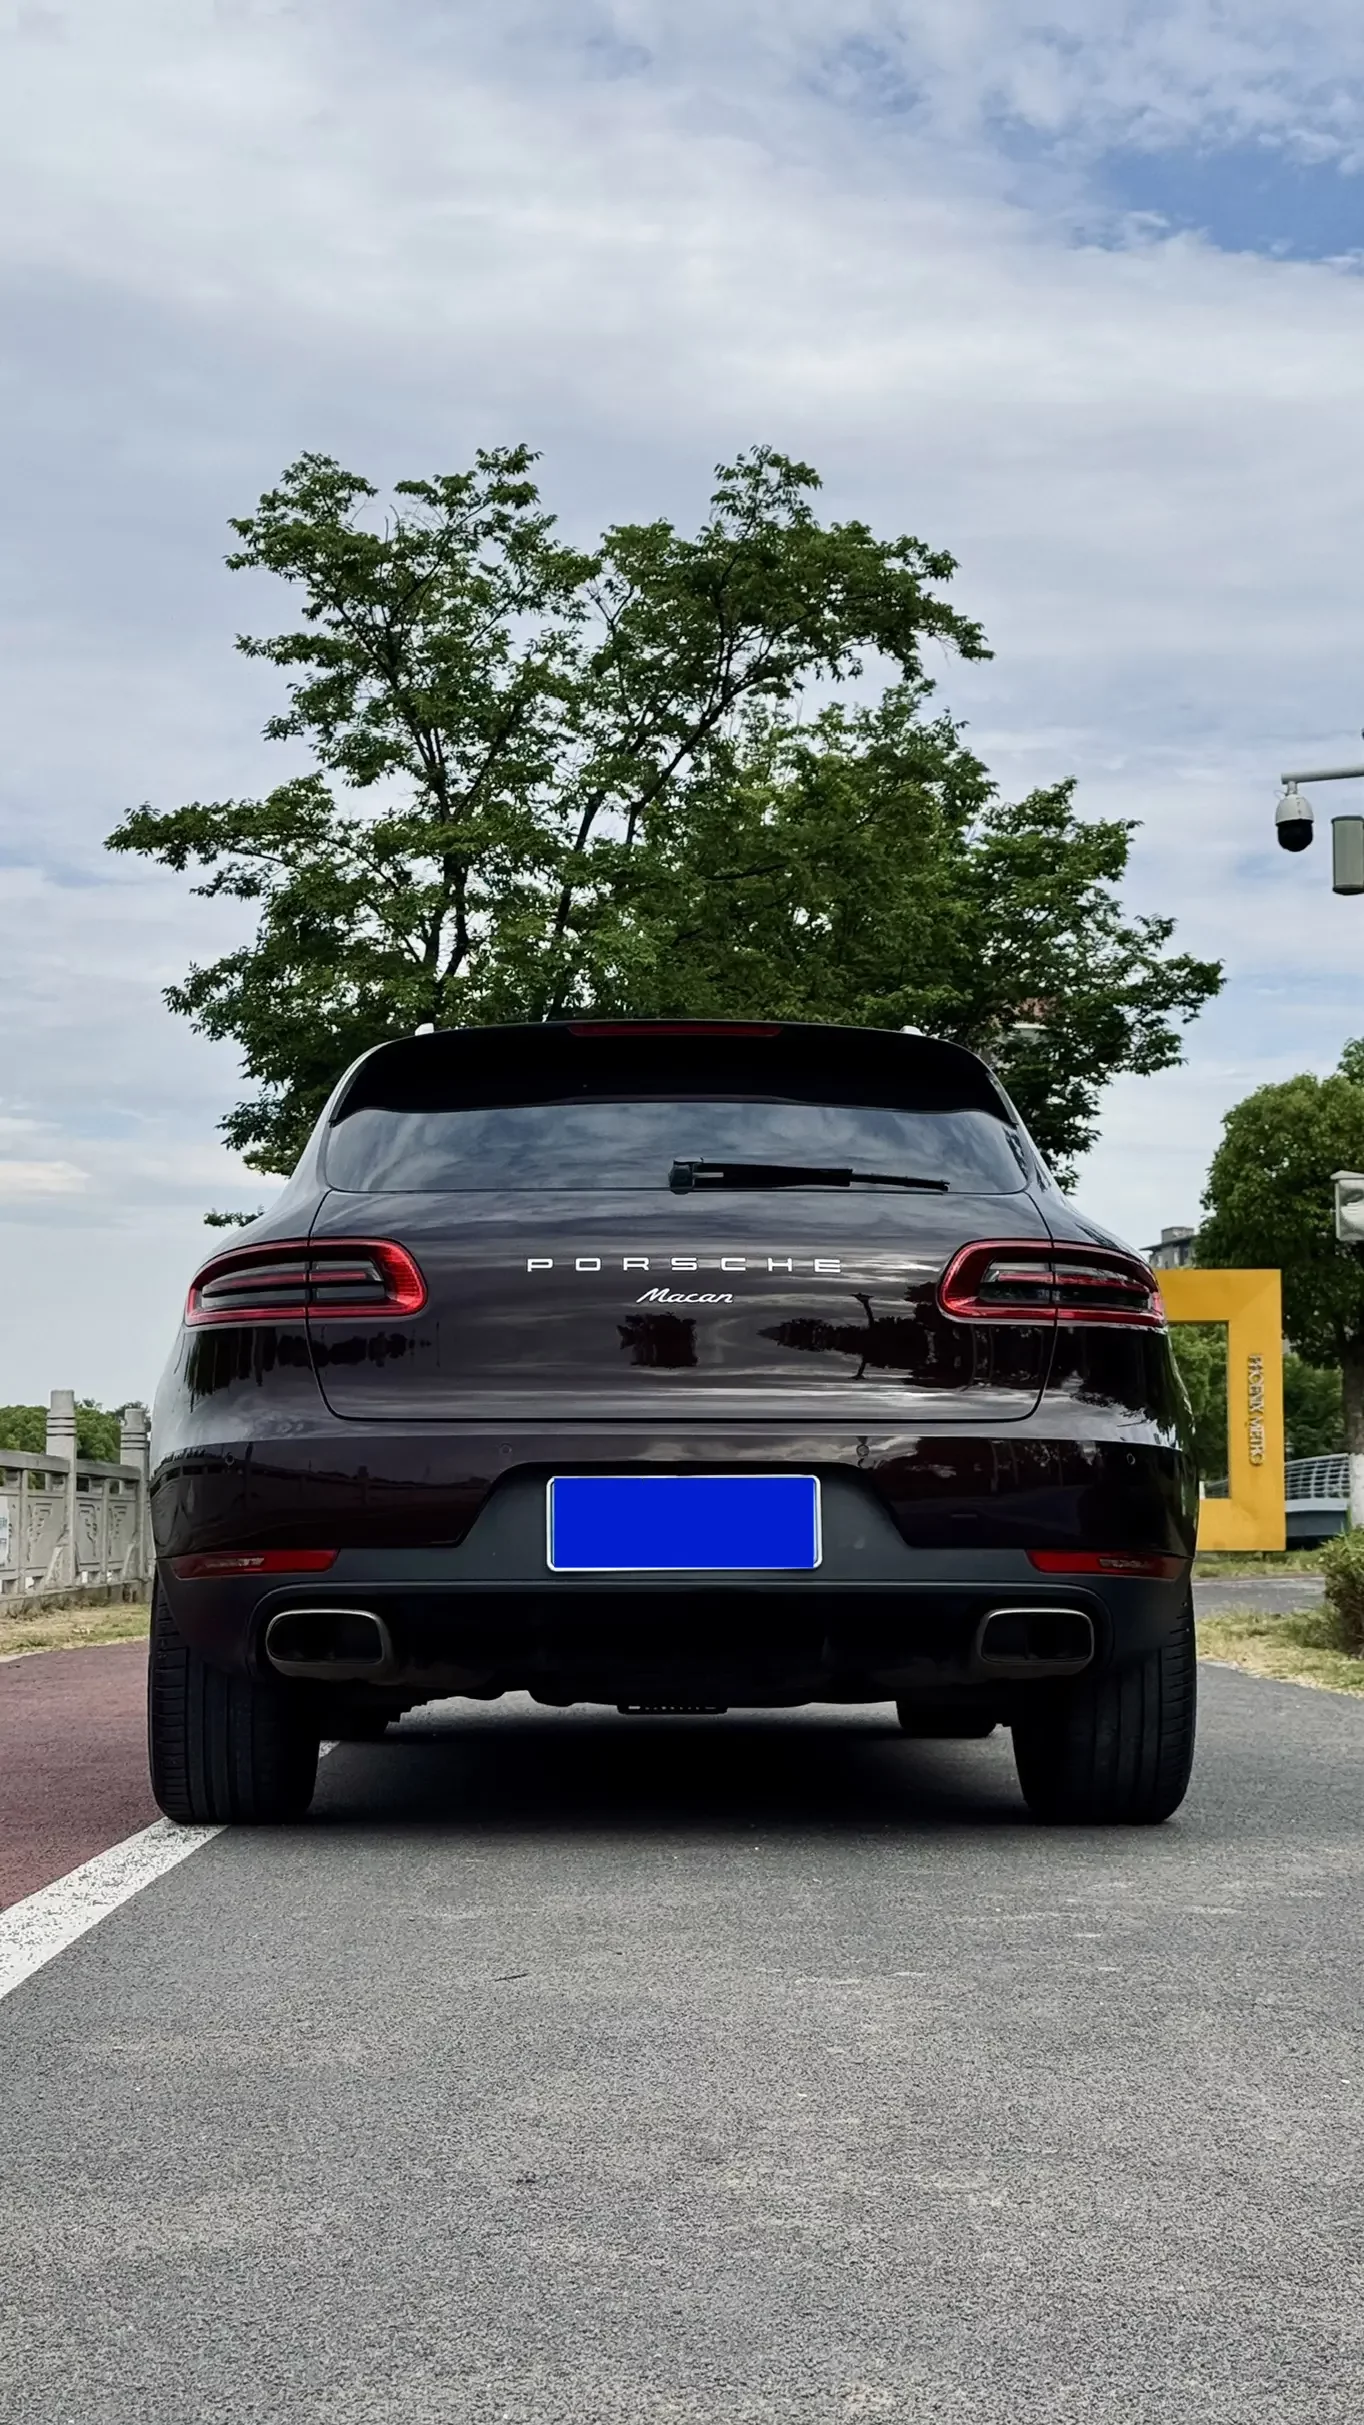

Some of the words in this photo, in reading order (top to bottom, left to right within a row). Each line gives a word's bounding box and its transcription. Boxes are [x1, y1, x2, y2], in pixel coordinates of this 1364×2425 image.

[527, 1257, 841, 1273] PORSCHE
[636, 1287, 733, 1304] Macan
[1248, 1355, 1264, 1414] PHOENIX
